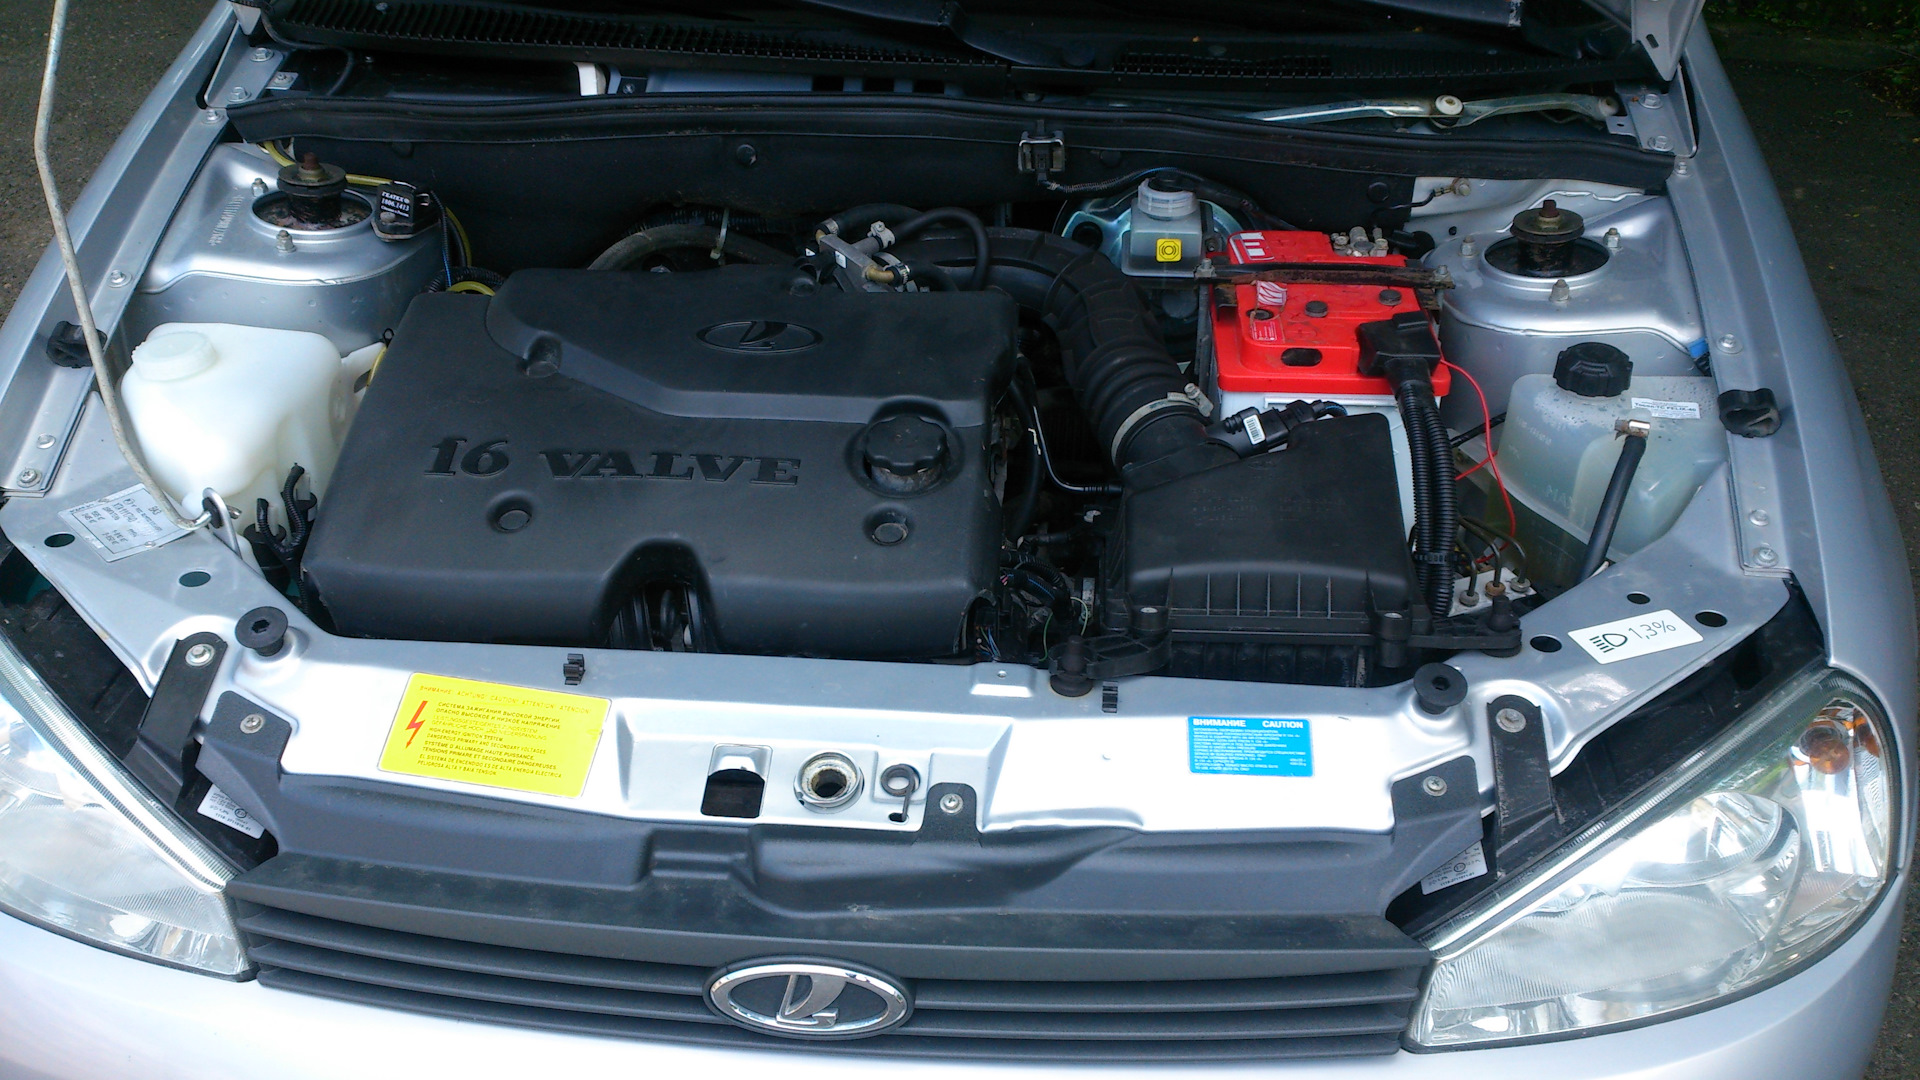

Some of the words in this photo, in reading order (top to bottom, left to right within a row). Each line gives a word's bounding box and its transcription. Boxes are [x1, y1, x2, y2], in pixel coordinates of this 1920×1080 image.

[424, 437, 509, 478] 16
[539, 450, 801, 486] VALVE
[1628, 620, 1676, 640] 1,3%
[436, 708, 459, 716] ОПАСНО
[461, 712, 490, 720] ВЫСОКОЕ
[438, 702, 465, 710] СИСТЕМА
[466, 706, 502, 715] ЗАЖИГАНИЯ
[1193, 718, 1247, 727] ВНИМАНИЕ
[1262, 720, 1304, 729] CAUTION
[427, 733, 457, 741] DANGEROUS
[491, 743, 520, 751] SECONDARY
